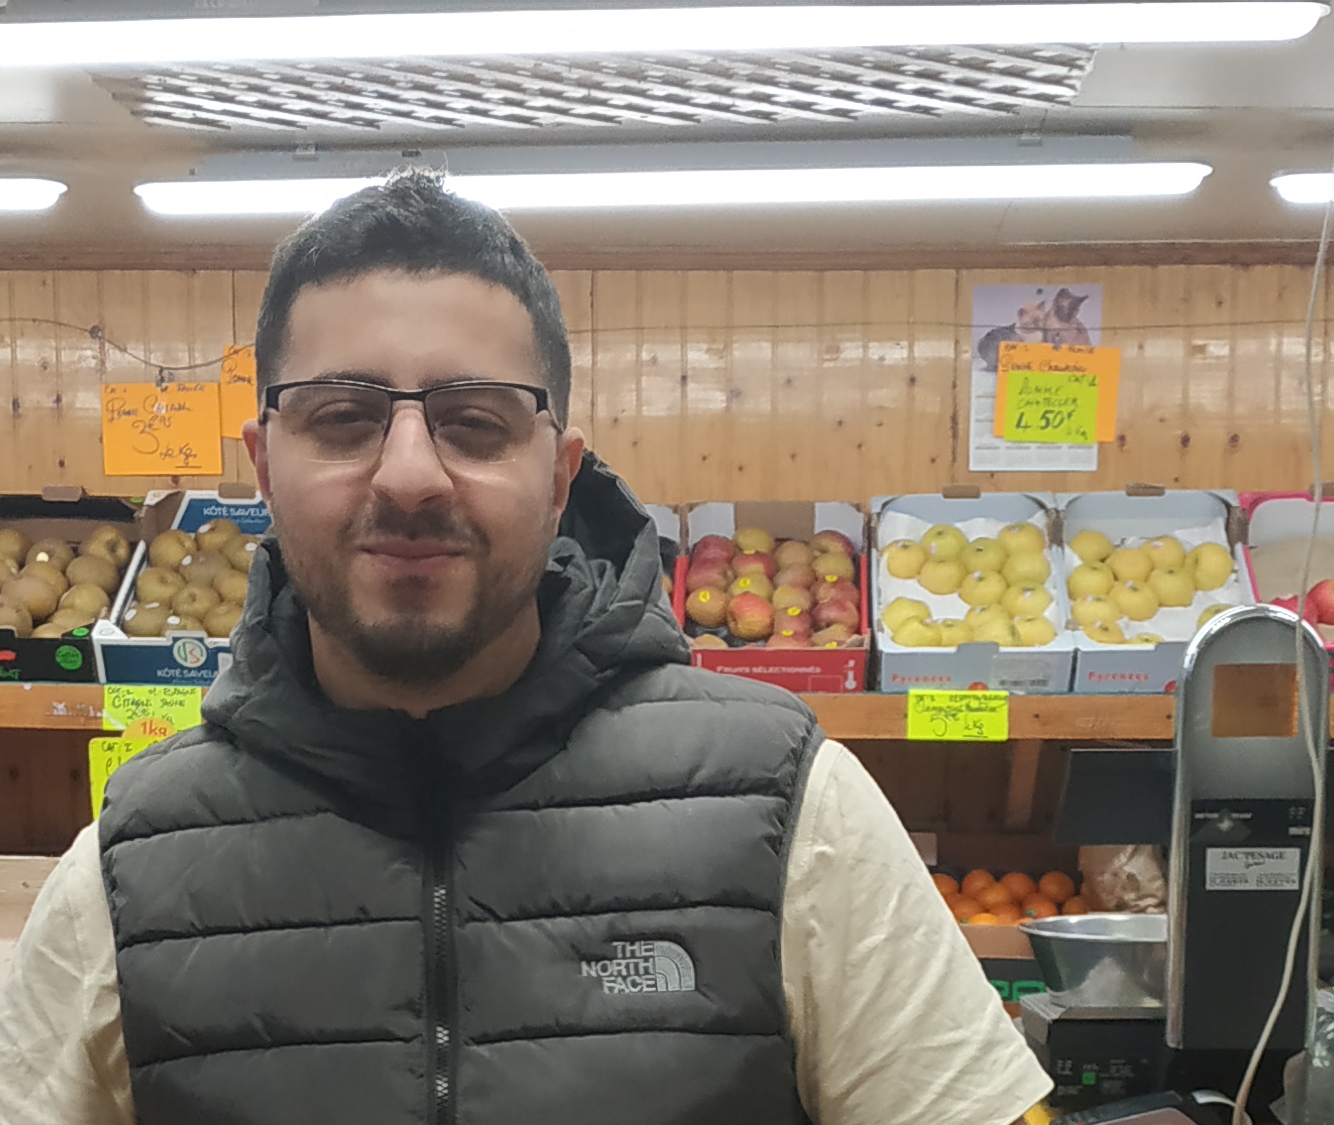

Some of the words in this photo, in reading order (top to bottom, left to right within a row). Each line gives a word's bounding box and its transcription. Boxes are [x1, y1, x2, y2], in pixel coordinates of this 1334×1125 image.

[612, 941, 655, 958] THE
[581, 958, 654, 977] NORTH
[603, 975, 657, 994] FACE
